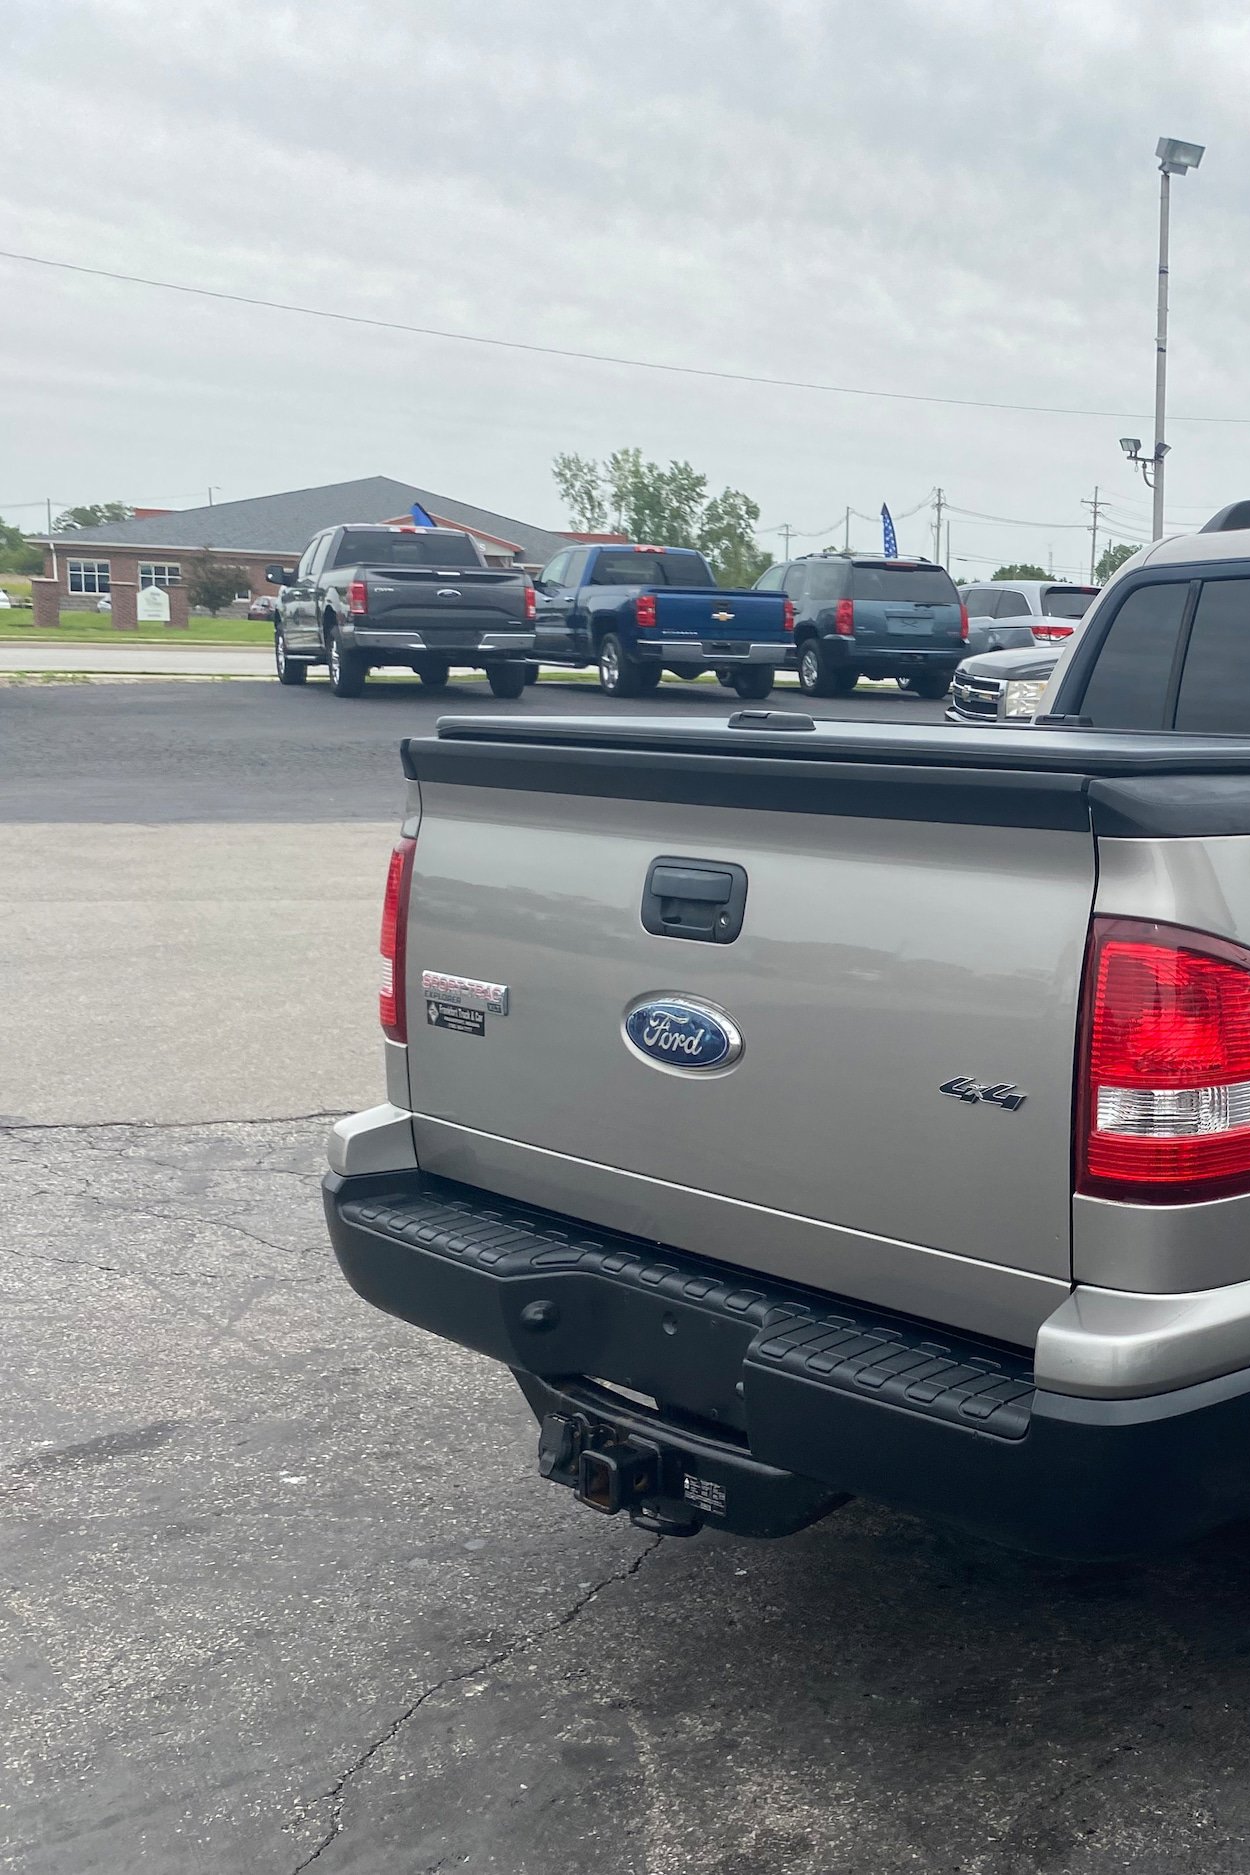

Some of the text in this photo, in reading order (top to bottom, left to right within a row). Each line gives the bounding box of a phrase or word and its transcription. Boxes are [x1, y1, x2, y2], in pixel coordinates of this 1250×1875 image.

[423, 974, 502, 1003] SPORT TRAC
[424, 990, 461, 1004] EXPLORER
[643, 1010, 705, 1056] Ford
